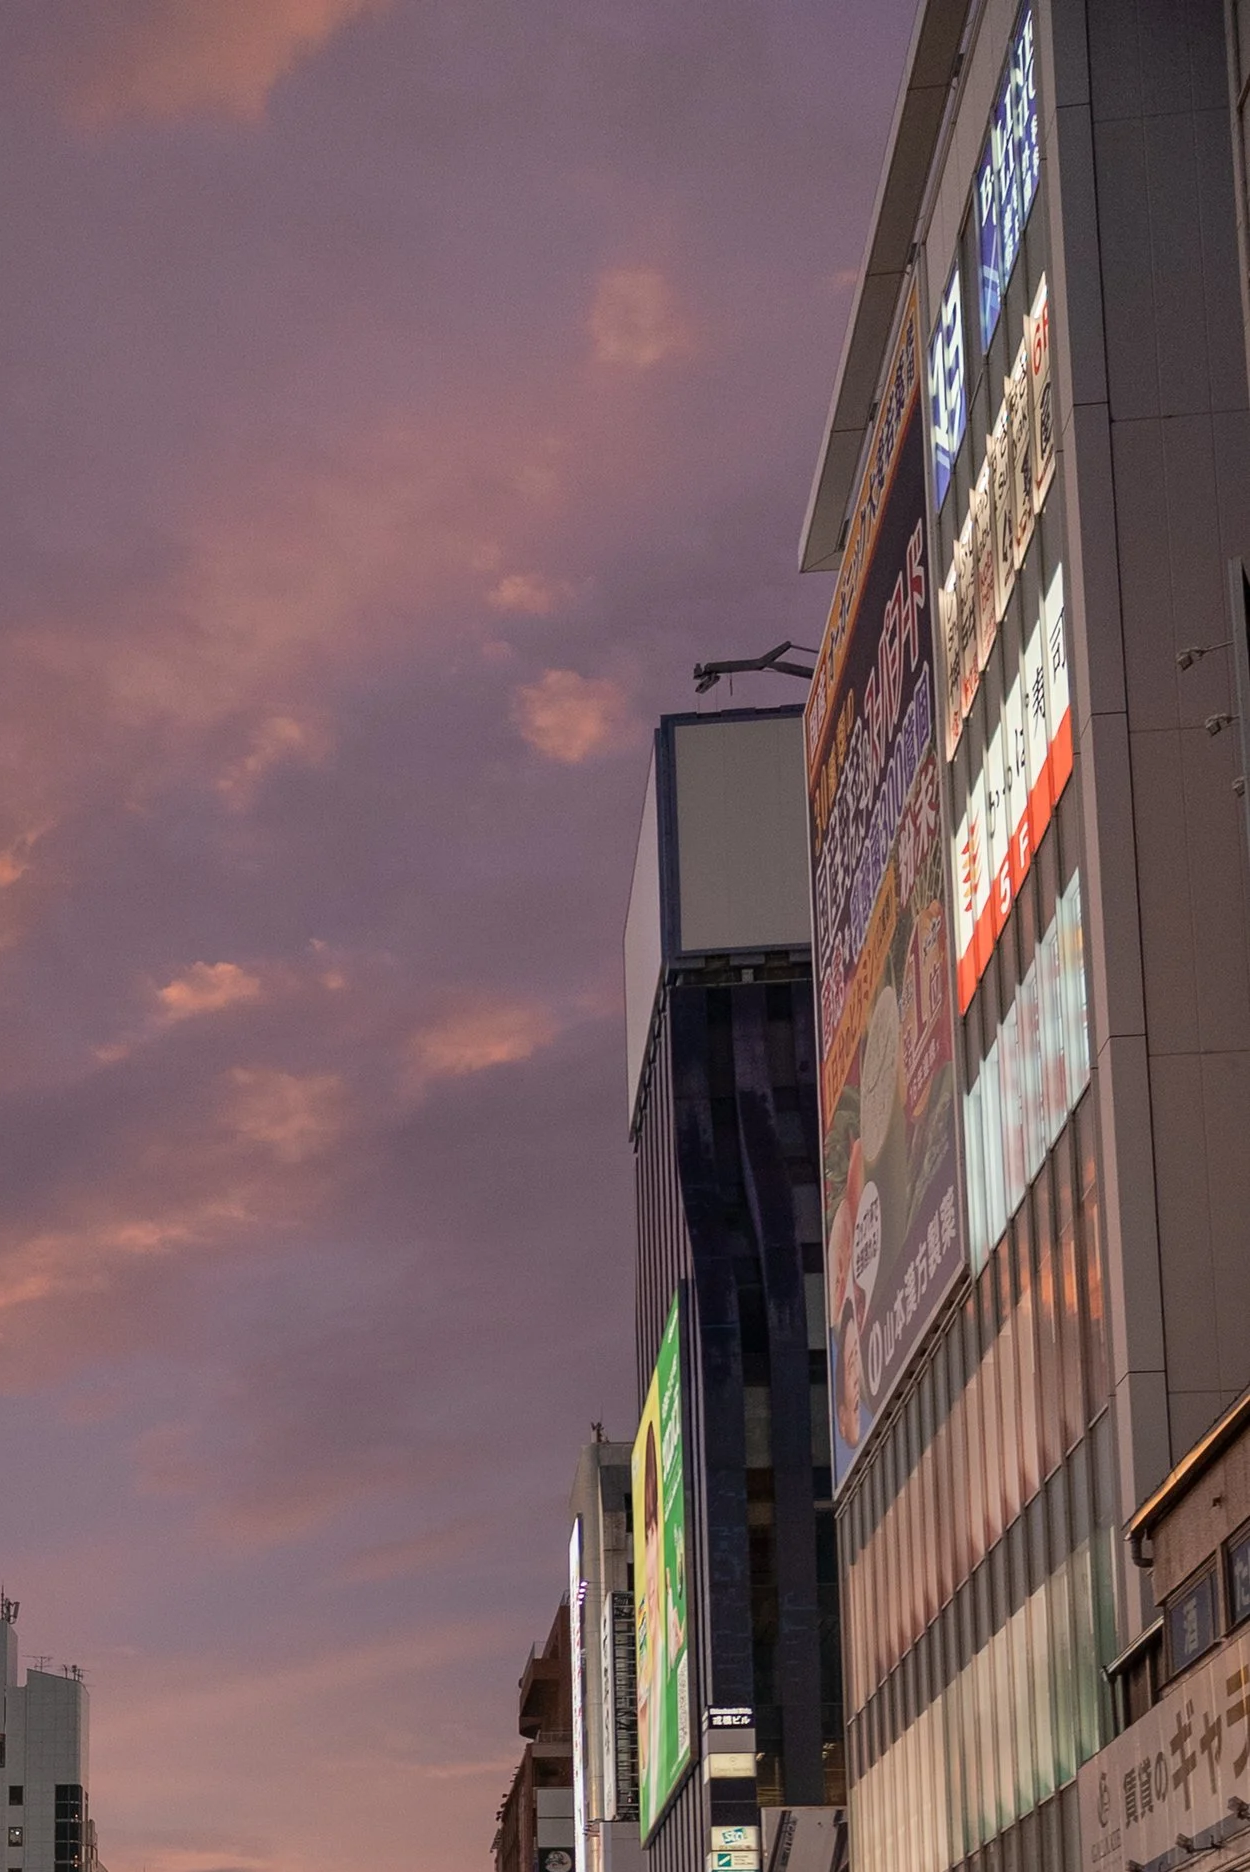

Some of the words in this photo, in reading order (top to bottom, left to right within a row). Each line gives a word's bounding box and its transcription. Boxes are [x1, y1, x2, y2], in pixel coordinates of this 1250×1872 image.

[883, 1178, 955, 1369] 山本漢方製薬
